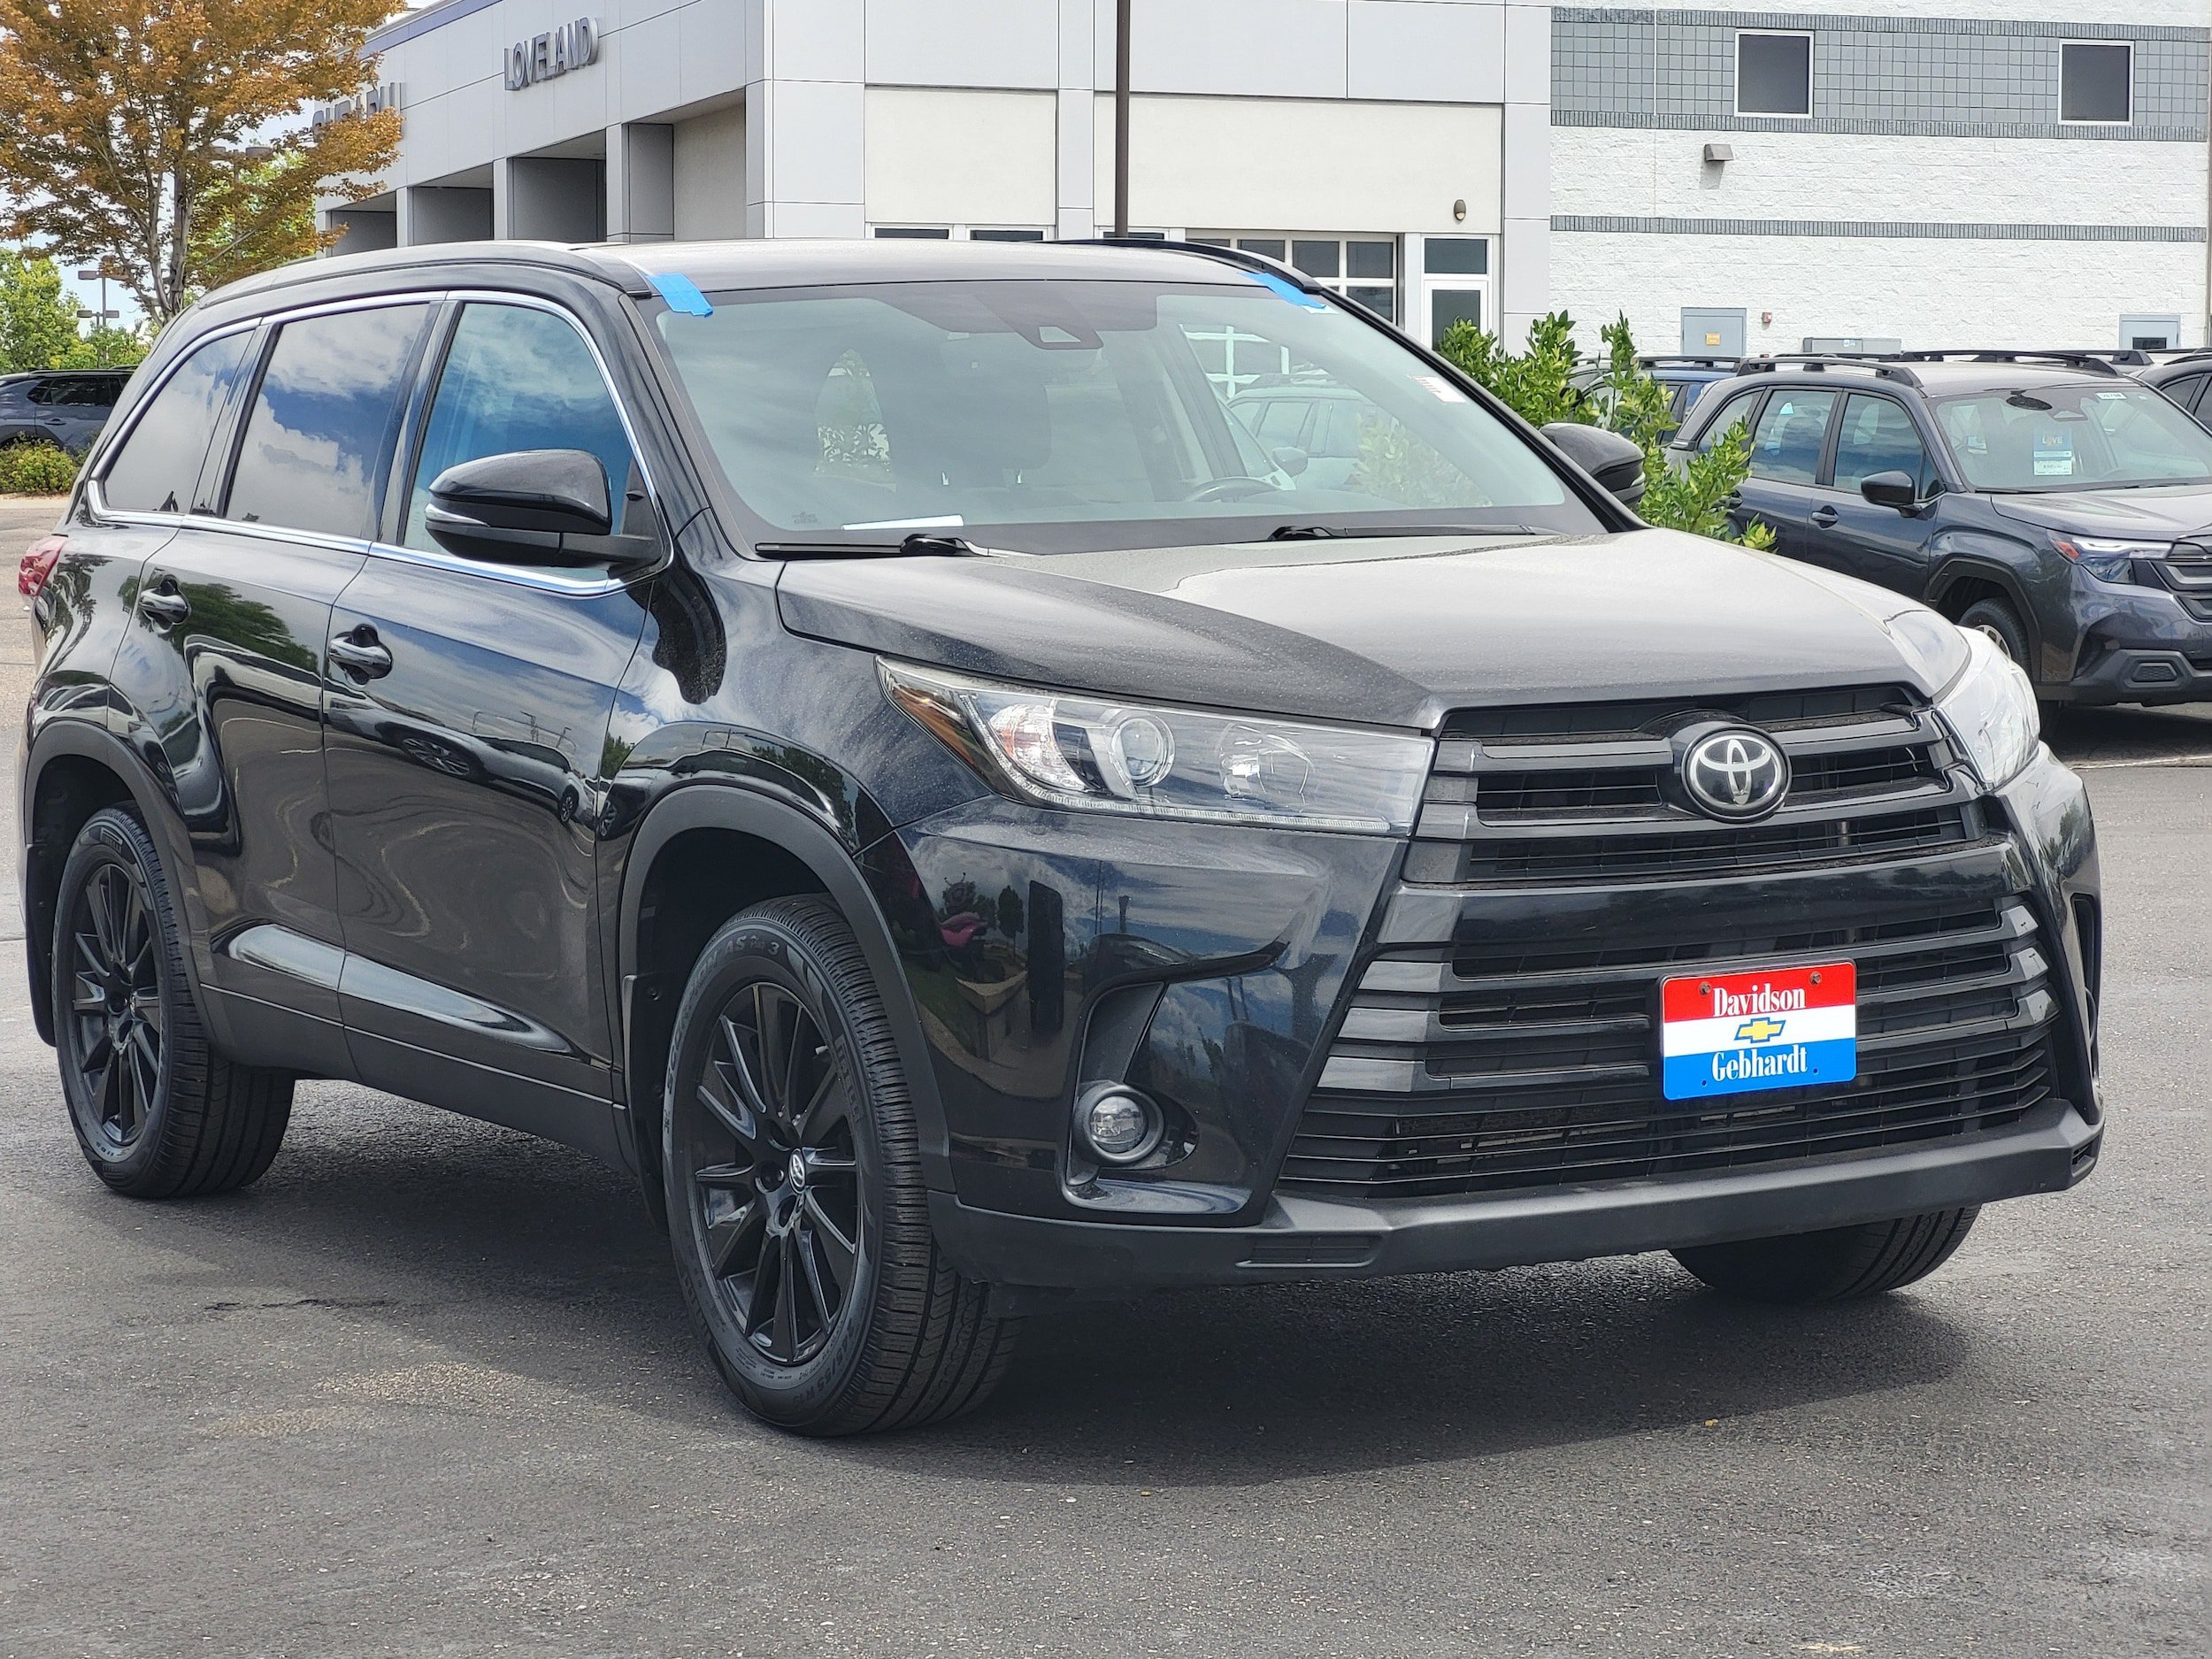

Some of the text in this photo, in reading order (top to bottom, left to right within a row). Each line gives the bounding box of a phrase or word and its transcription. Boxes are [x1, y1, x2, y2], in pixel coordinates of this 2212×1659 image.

[503, 16, 599, 90] LOVELAND
[767, 941, 780, 956] 3
[1712, 983, 1806, 1017] Davidson
[1712, 1044, 1807, 1081] Gebhardt
